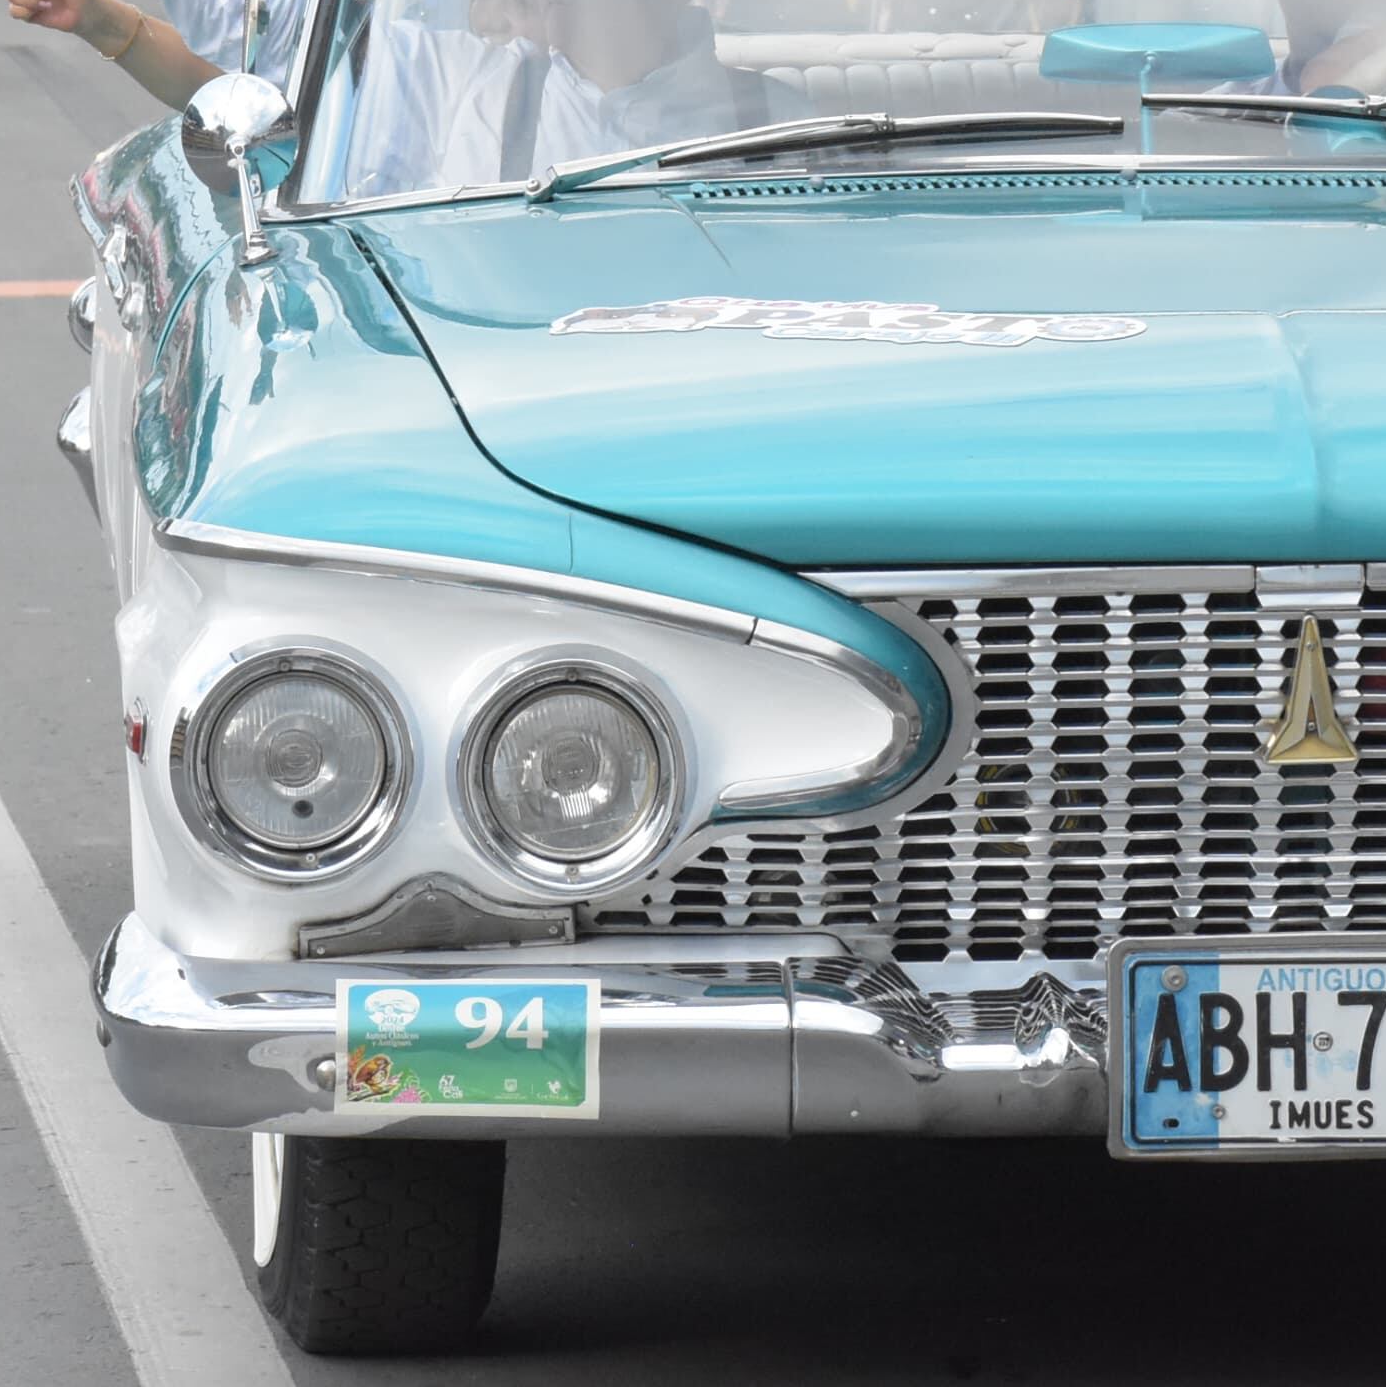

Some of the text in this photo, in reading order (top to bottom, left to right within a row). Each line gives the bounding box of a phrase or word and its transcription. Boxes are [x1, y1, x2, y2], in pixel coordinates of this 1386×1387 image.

[1256, 967, 1386, 993] ANTIGUO
[454, 996, 550, 1050] 94
[1142, 990, 1308, 1093] ABH
[1268, 1099, 1375, 1130] IMUES
